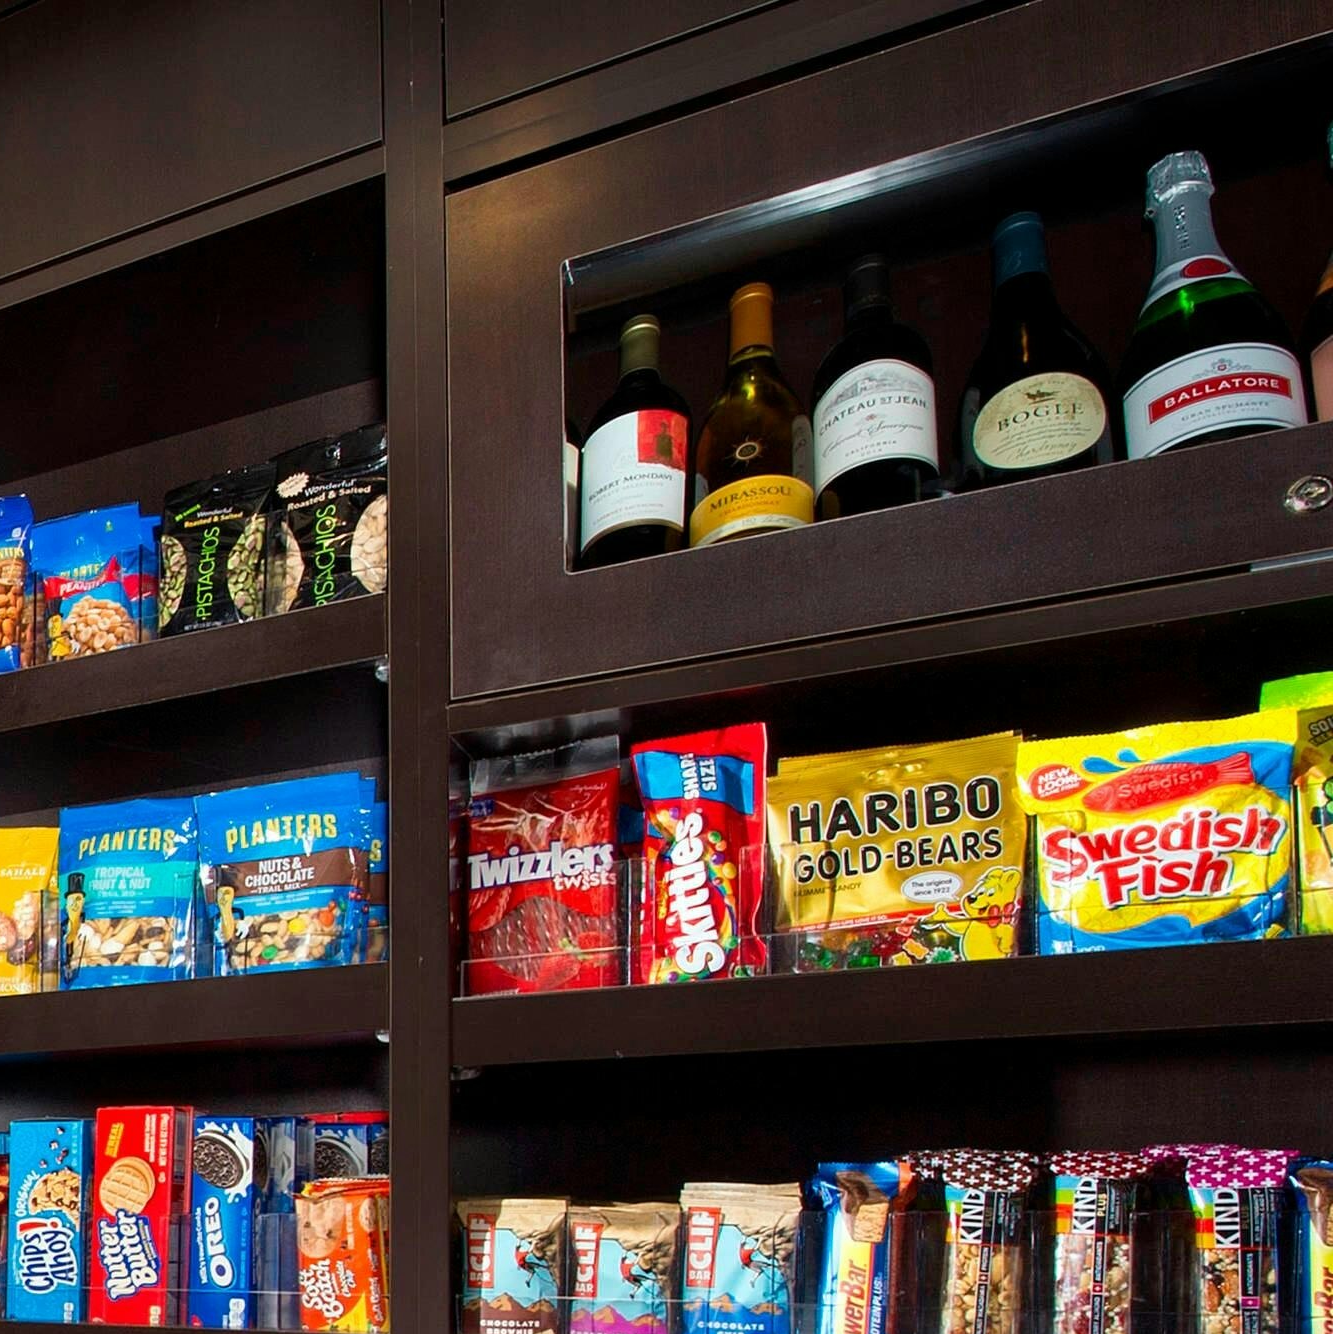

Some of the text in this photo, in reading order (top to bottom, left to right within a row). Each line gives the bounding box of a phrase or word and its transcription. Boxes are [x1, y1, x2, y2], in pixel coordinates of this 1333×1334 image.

[1164, 377, 1280, 409] BALLATORE
[820, 396, 927, 437] CHATEAU JEAN
[997, 402, 1084, 432] BOGLE
[304, 479, 357, 497] Wonderful
[623, 472, 673, 483] MONDAVI
[287, 485, 371, 511] Roasted & Salted
[709, 485, 792, 512] MIRASSOU
[701, 759, 717, 792] SIZE
[1038, 768, 1071, 784] NEW
[1118, 769, 1204, 799] Swedish
[788, 775, 1001, 846] HARIBO
[79, 828, 176, 861] PLANTERS
[225, 814, 338, 854] PLANTERS
[1044, 808, 1281, 882] Swedish
[0, 867, 47, 878] SAHALE
[95, 865, 145, 879] TROPICAL
[258, 857, 302, 875] NUTS &
[467, 842, 614, 890] Twizzlers
[794, 829, 1003, 884] GOLD-BEARS
[245, 867, 316, 887] CHOCOLATE
[553, 869, 617, 892] twists
[671, 812, 725, 975] Skittles
[928, 877, 953, 889] original
[1095, 851, 1230, 905] Fish
[15, 1171, 40, 1217] ORIGINAL
[1073, 1178, 1097, 1234] KIND
[1097, 1193, 1107, 1217] PLUS
[960, 1189, 985, 1243] KIND
[1214, 1189, 1240, 1247] KIND
[117, 1211, 159, 1287] Butter
[205, 1196, 234, 1287] OREO
[471, 1218, 494, 1272] CLIF
[577, 1225, 598, 1281] CLIF
[689, 1209, 719, 1271] CLIF
[23, 1233, 55, 1292] Chips
[99, 1219, 135, 1299] Nutter
[689, 1270, 712, 1281] BAR
[313, 1259, 344, 1317] Batch
[470, 1271, 491, 1283] BAR
[575, 1282, 594, 1294] BAR
[480, 1319, 540, 1328] CHOCOLATE
[698, 1321, 765, 1331] CHOCOLATE
